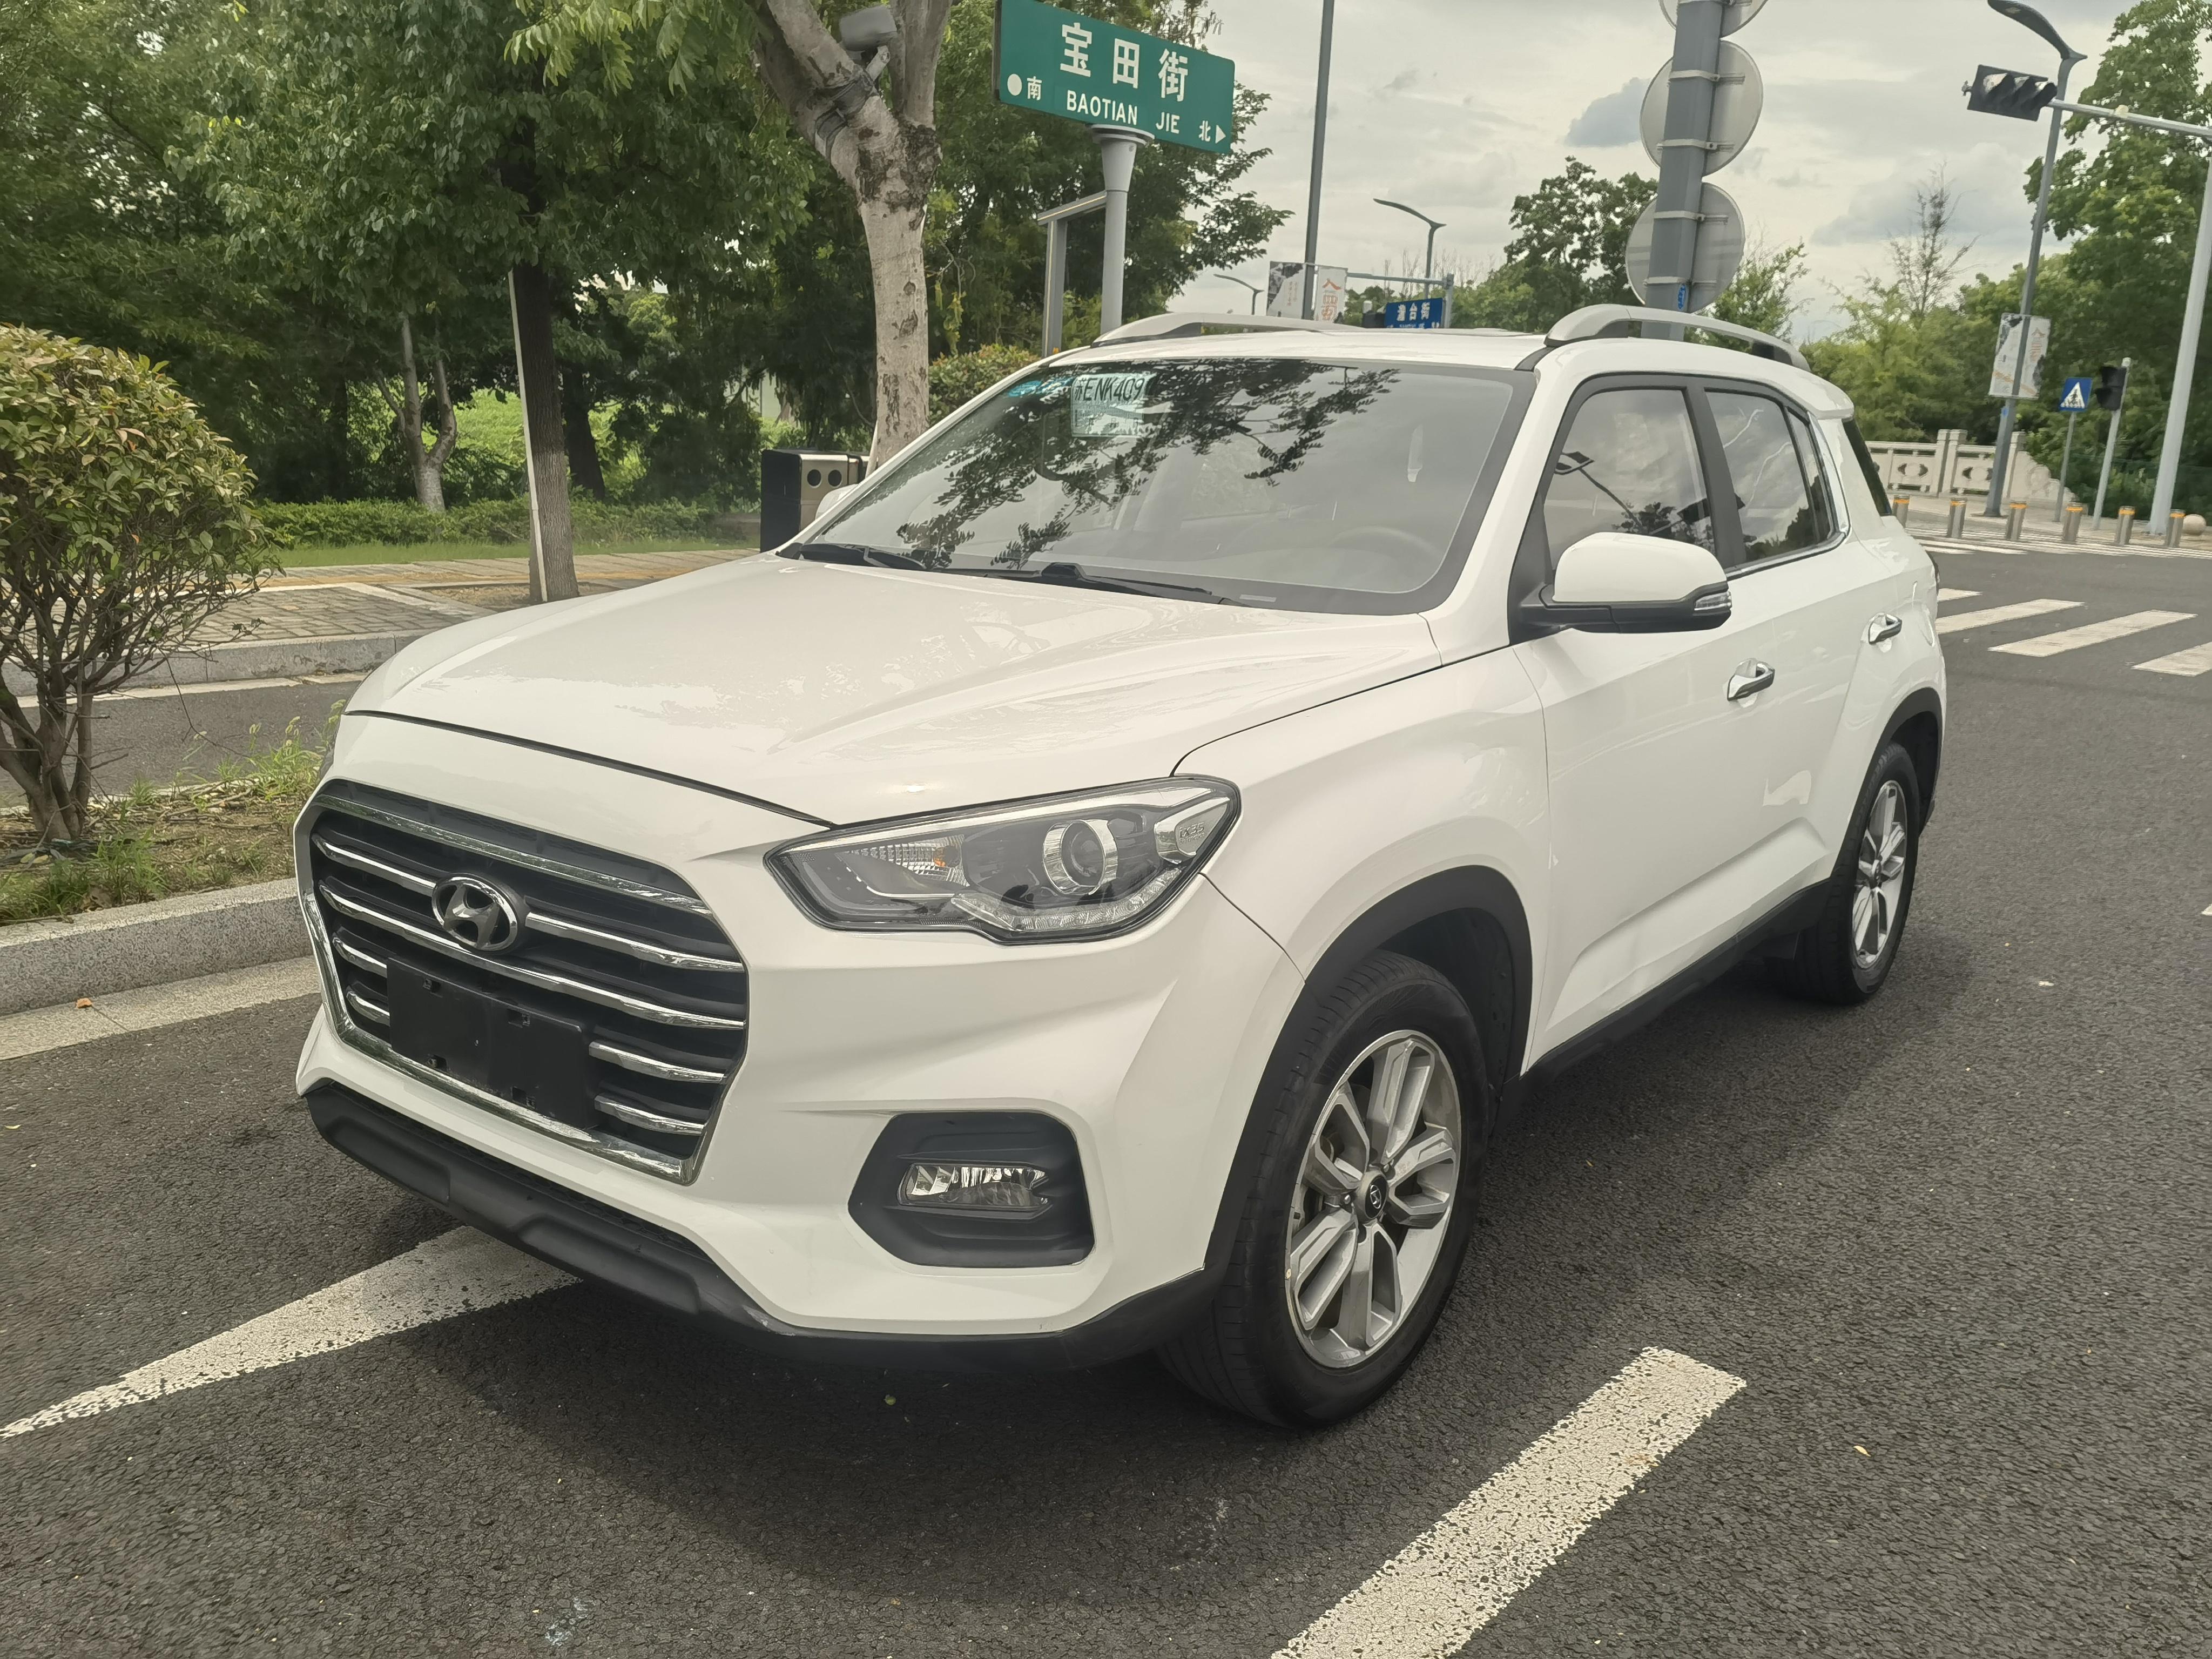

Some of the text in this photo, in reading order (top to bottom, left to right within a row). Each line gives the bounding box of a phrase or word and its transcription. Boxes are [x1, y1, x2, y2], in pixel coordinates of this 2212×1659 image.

[1060, 22, 1188, 102] 宝田街
[1027, 76, 1042, 101] 南
[1067, 90, 1180, 134] BAOTIAN JIE
[1198, 120, 1211, 142] 北
